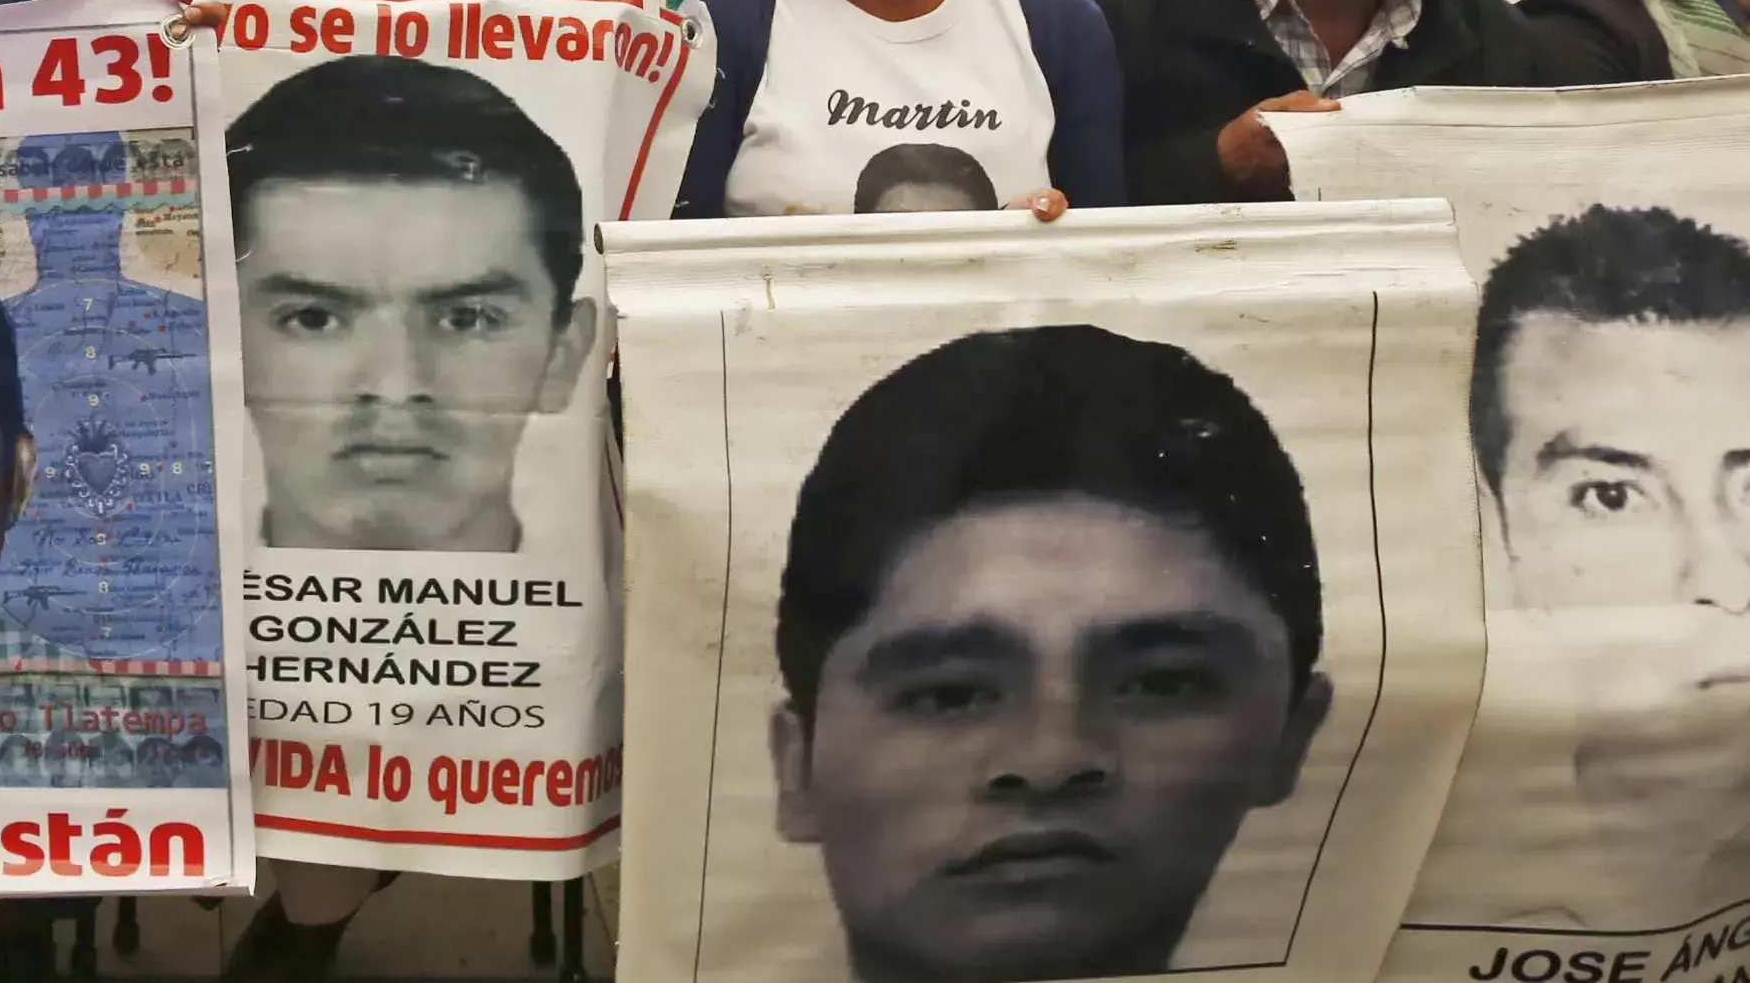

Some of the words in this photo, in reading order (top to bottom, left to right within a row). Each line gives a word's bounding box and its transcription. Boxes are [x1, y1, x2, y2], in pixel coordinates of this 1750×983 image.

[290, 6, 355, 54] se
[375, 3, 430, 58] lo
[447, 2, 674, 84] llevaron!
[30, 31, 176, 107] 43!
[826, 89, 1003, 131] Martin
[243, 568, 363, 604] ÉSAR
[377, 577, 584, 608] MANUEL
[249, 612, 518, 648] GONZÁLEZ
[38, 703, 208, 738] Tlatempa
[367, 701, 415, 726] 19
[426, 699, 546, 729] AÑOS
[366, 743, 412, 803] lo
[1659, 915, 1750, 982] ÁNG
